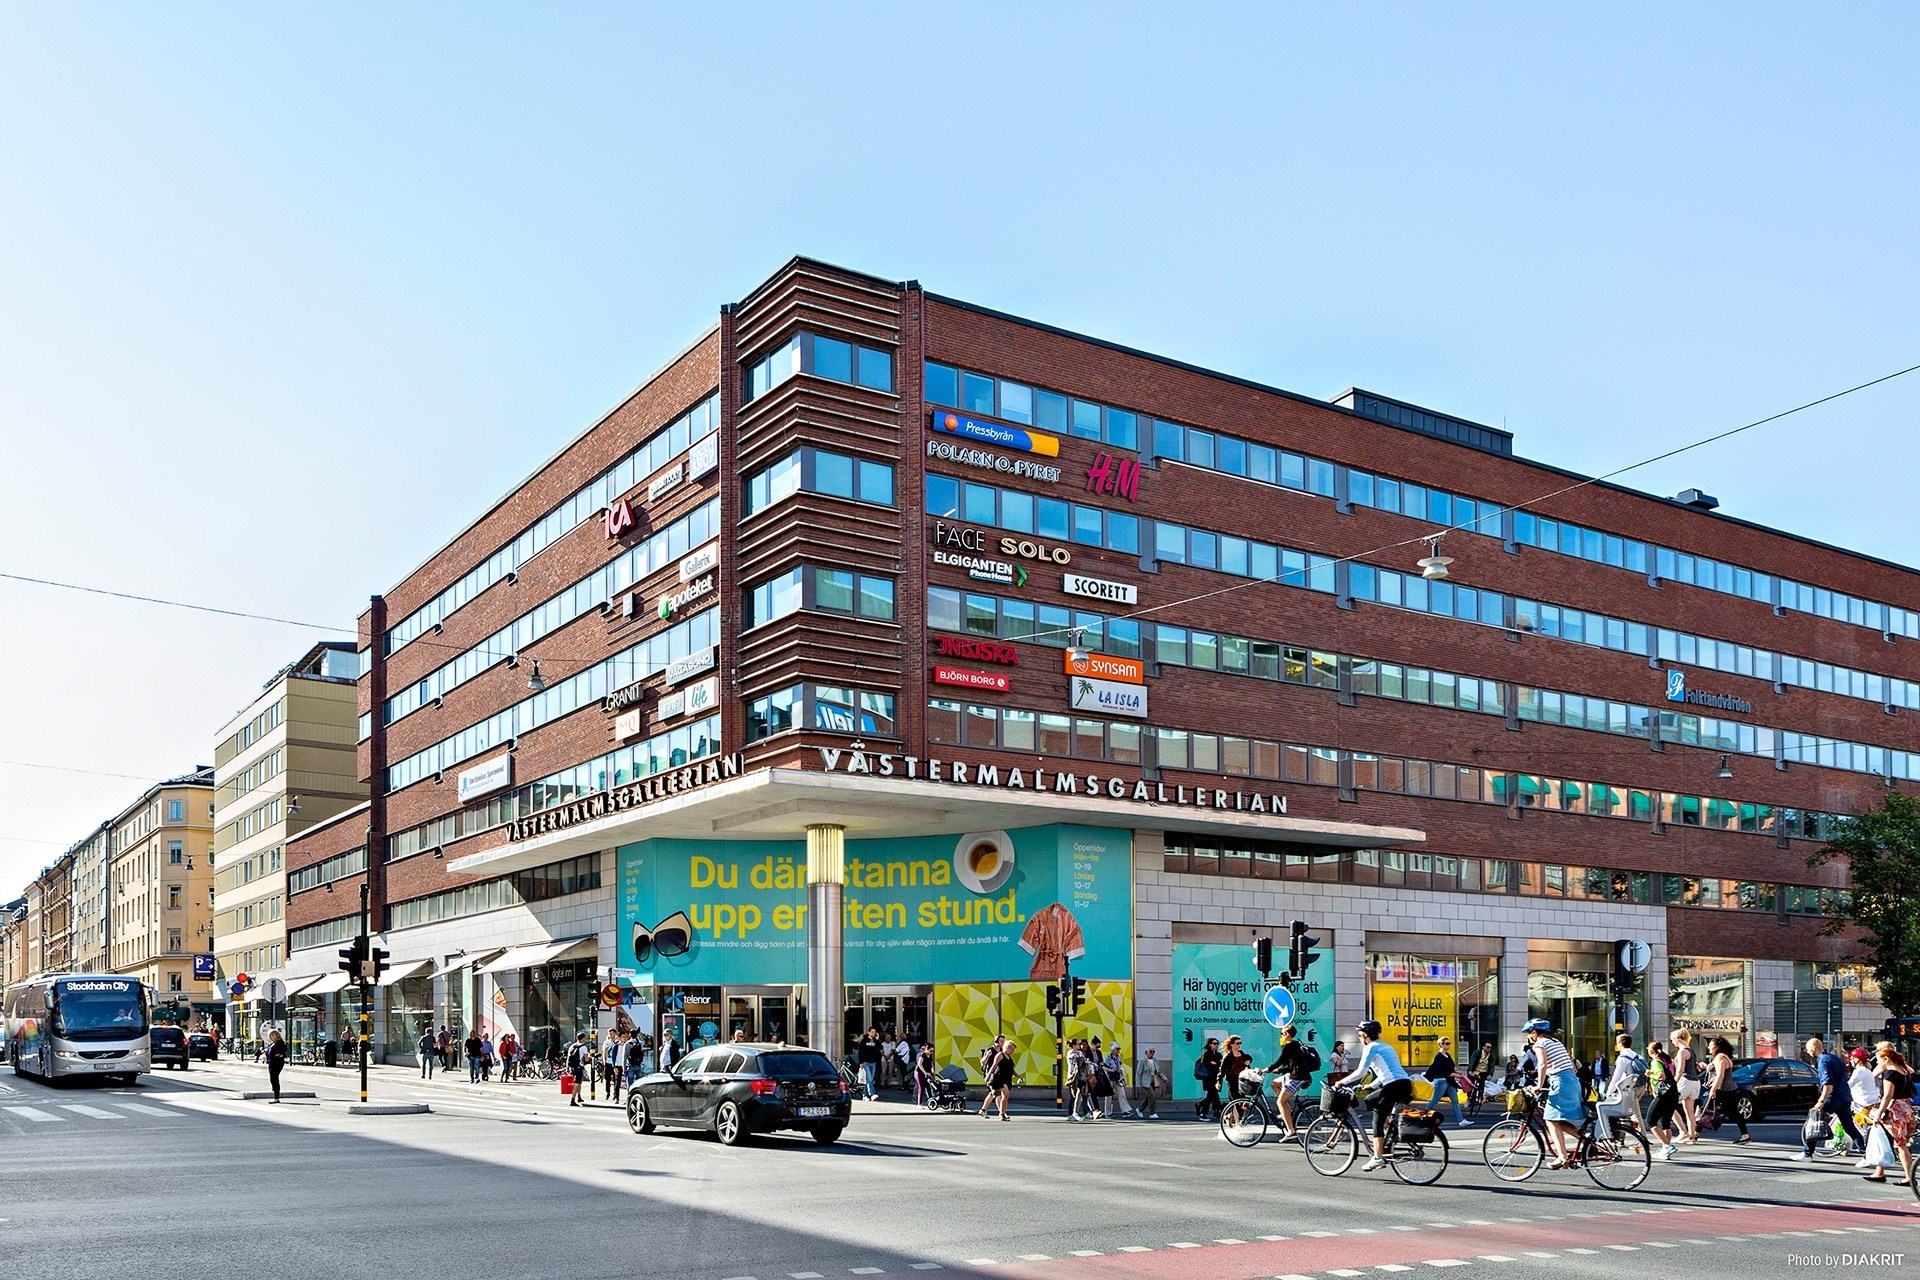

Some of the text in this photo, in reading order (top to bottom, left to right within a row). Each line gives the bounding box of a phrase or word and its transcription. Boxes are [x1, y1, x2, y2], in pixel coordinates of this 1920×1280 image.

[965, 421, 1014, 442] Pressbyrån
[927, 441, 995, 469] POLARN
[1016, 459, 1061, 483] PYRET
[1087, 453, 1141, 501] H&M
[605, 499, 632, 540] ICA
[935, 523, 985, 552] FACE
[934, 551, 1013, 575] ELGIGANTEN
[1001, 537, 1071, 565] SOLO
[669, 575, 713, 612] apoteket
[1074, 578, 1128, 600] SCORETT
[935, 635, 1019, 665] INDISKA
[667, 654, 711, 679] VAGABOND
[940, 670, 995, 686] BJÖRN BORG
[606, 682, 642, 711] GRANIT
[691, 684, 708, 708] life
[1098, 690, 1111, 704] LA
[1115, 693, 1139, 708] ISLA
[1685, 687, 1751, 713] Folktandvården
[820, 741, 1287, 814] VÄSTERMALMSGALLERIAN
[505, 753, 743, 841] VÄSTERMALMSGALLERIAN
[1073, 843, 1106, 853] Öppettider
[690, 856, 738, 888] Du
[689, 904, 761, 939] upp
[843, 899, 906, 929] iten
[917, 889, 1026, 927] stund.
[769, 940, 786, 948] tiden
[787, 940, 795, 949] på
[866, 939, 874, 947] för
[875, 939, 885, 948] dig
[902, 939, 915, 947] eller
[196, 958, 204, 969] P
[66, 982, 129, 992] Stockholm City
[1183, 978, 1203, 992] Här
[1207, 978, 1248, 996] bygger
[1251, 979, 1261, 992] vi
[1264, 982, 1279, 993] o
[1303, 981, 1319, 994] att
[683, 995, 711, 1004] telenor
[1183, 997, 1197, 1011] bli
[1200, 998, 1230, 1011] ännu
[1391, 997, 1401, 1010] VI
[1387, 1010, 1447, 1027] PÅ SVERIGE!
[1899, 1024, 1905, 1035] 3
